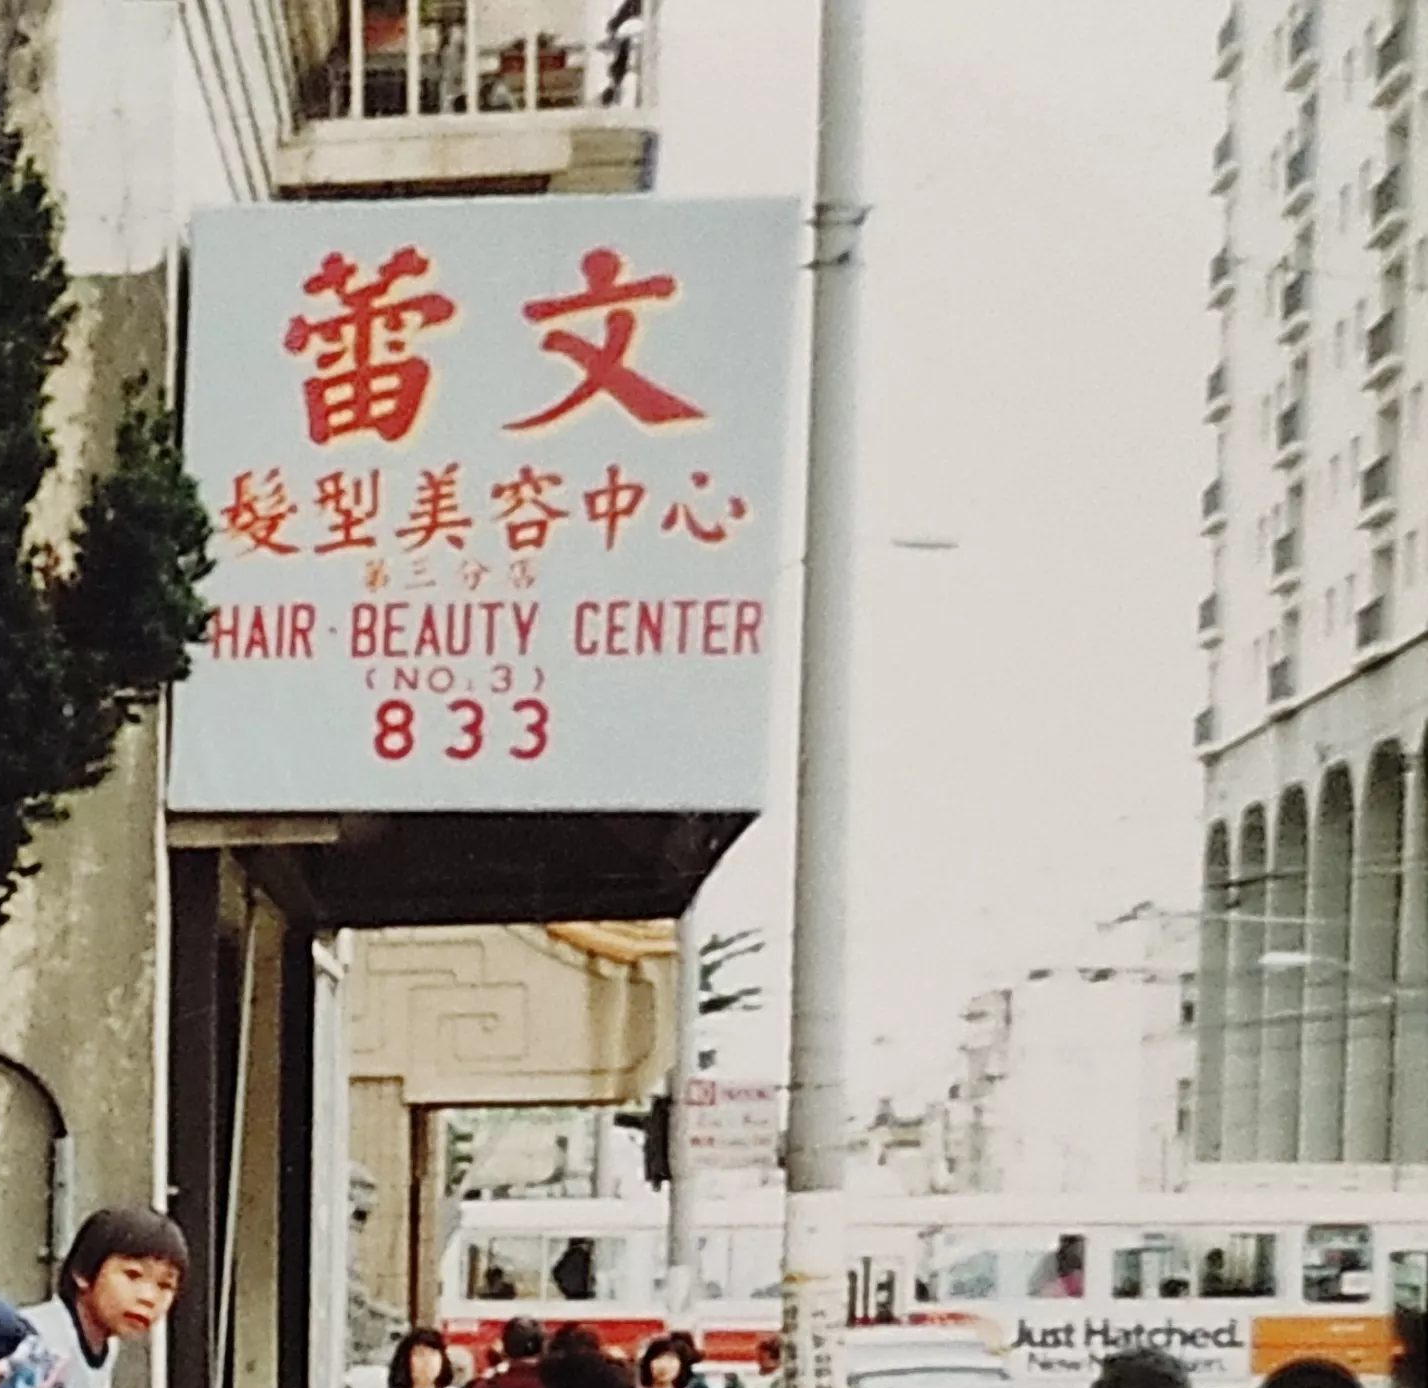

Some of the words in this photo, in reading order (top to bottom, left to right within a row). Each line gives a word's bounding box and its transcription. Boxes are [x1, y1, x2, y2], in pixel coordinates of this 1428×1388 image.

[217, 460, 748, 557] 髮型美容中心
[211, 602, 317, 660] HAIR
[350, 601, 540, 659] BEAUTY
[574, 599, 764, 656] CENTER
[373, 698, 549, 761] 833
[1011, 1317, 1075, 1348] Just
